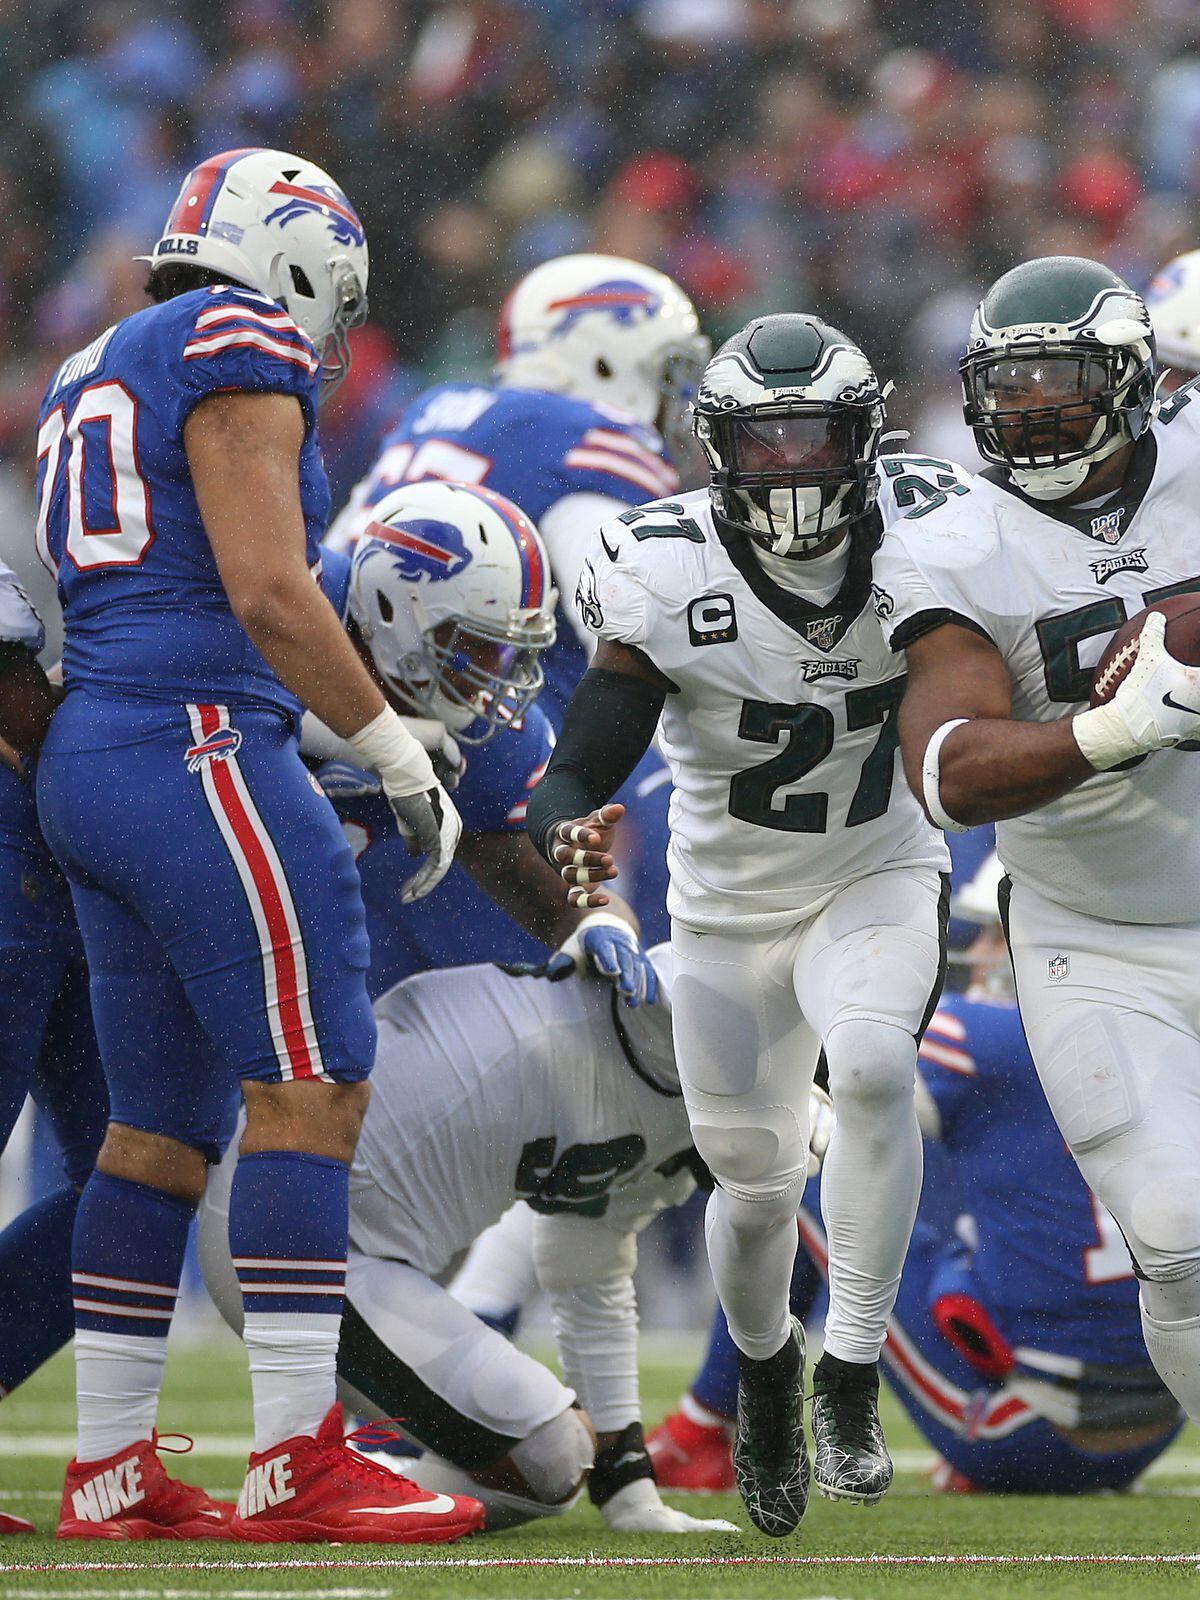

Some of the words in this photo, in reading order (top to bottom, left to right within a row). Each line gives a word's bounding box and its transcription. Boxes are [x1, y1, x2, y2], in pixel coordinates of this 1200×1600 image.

[52, 325, 118, 398] FORD
[36, 378, 156, 583] 70
[879, 456, 971, 520] 27
[617, 502, 707, 544] 27
[1088, 548, 1150, 585] EAGLES
[691, 597, 734, 634] C
[800, 658, 862, 684] EAGLES
[728, 670, 908, 834] 27
[1050, 965, 1067, 978] NFL
[71, 1455, 146, 1523] NIKE
[236, 1453, 297, 1521] NIKE
